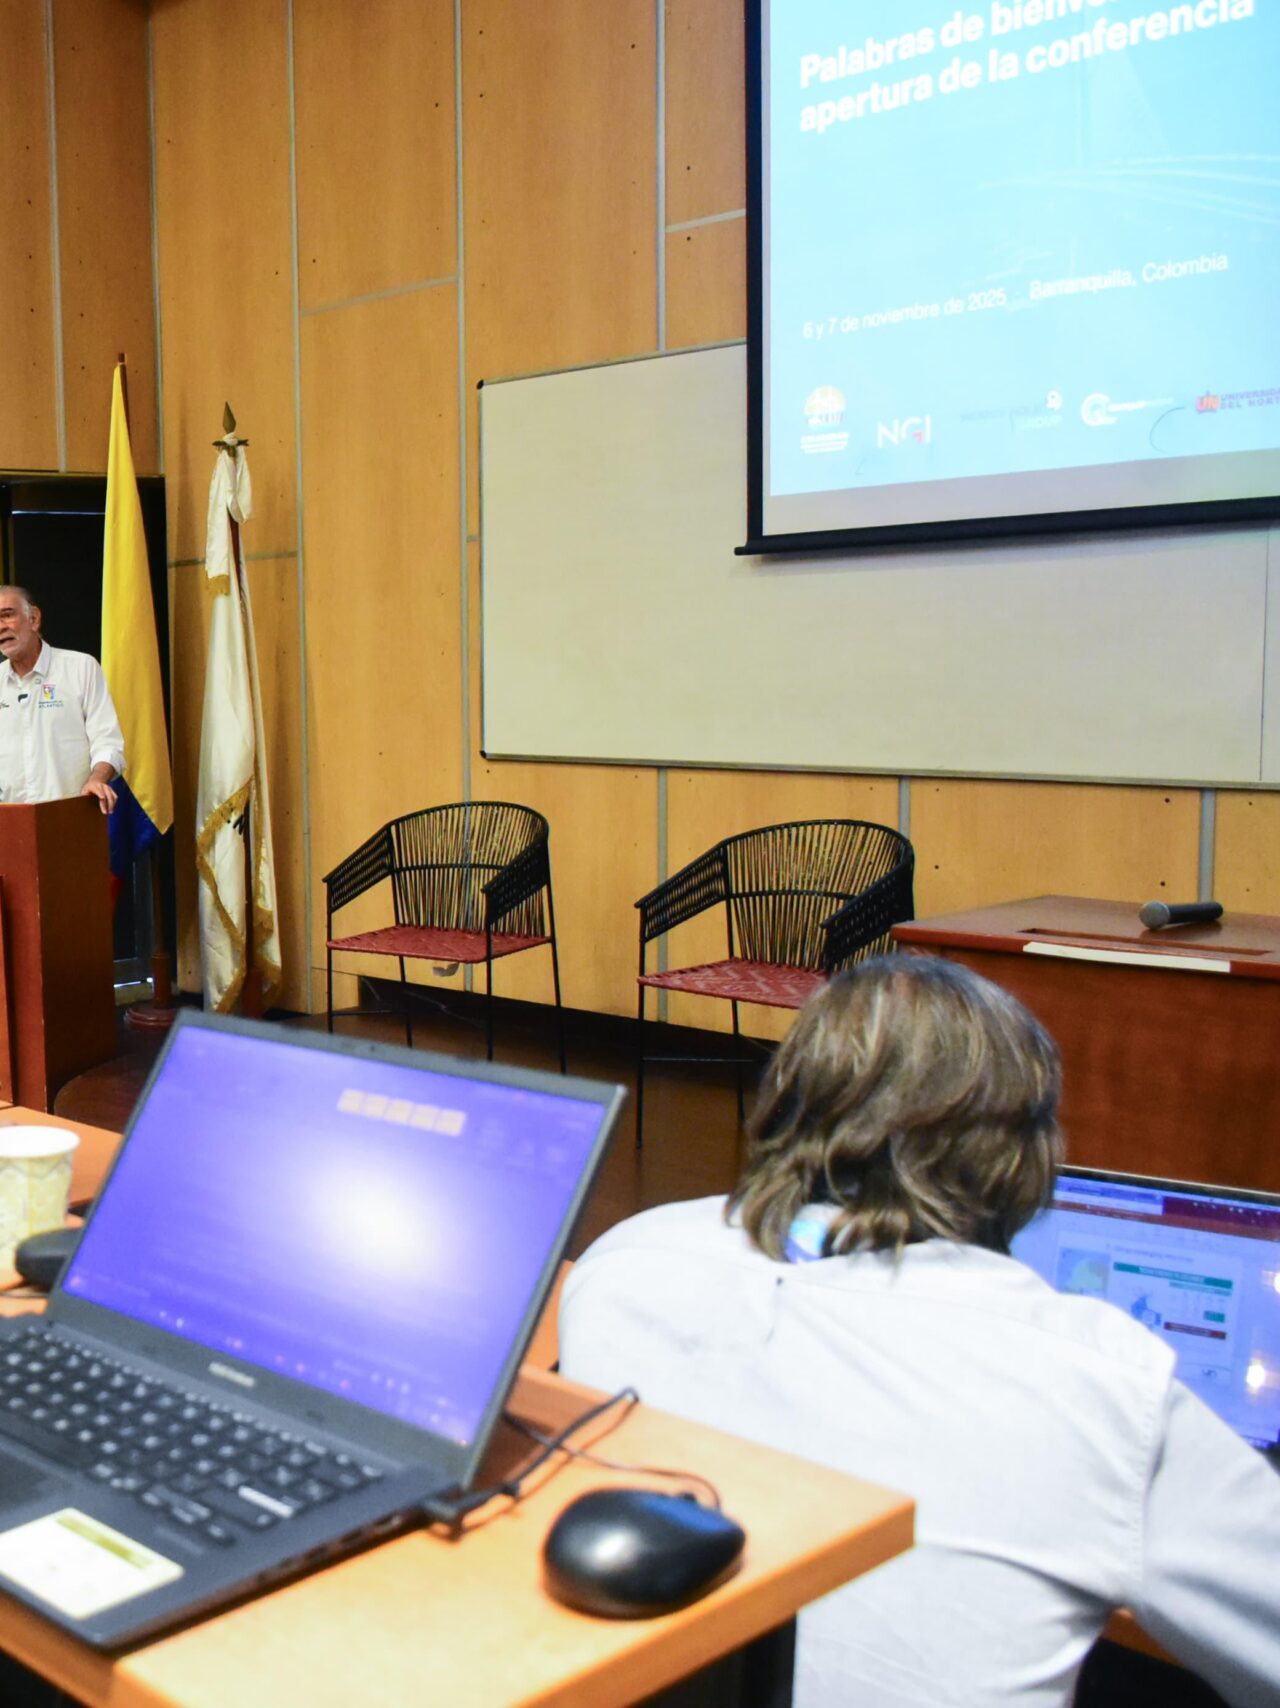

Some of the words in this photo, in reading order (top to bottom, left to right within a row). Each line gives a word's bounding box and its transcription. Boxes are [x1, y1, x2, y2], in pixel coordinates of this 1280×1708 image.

[799, 24, 935, 89] Palabras
[939, 11, 985, 49] de
[799, 73, 933, 134] apertura
[938, 57, 983, 94] de
[988, 48, 1020, 83] la
[1025, 0, 1255, 74] conferencia
[802, 320, 814, 339] 6
[816, 323, 825, 340] y
[828, 317, 839, 335] 7
[840, 316, 861, 334] de
[863, 303, 940, 330] noviembre
[943, 296, 964, 316] de
[967, 287, 1008, 312] 2025
[1142, 252, 1229, 284] Colombia
